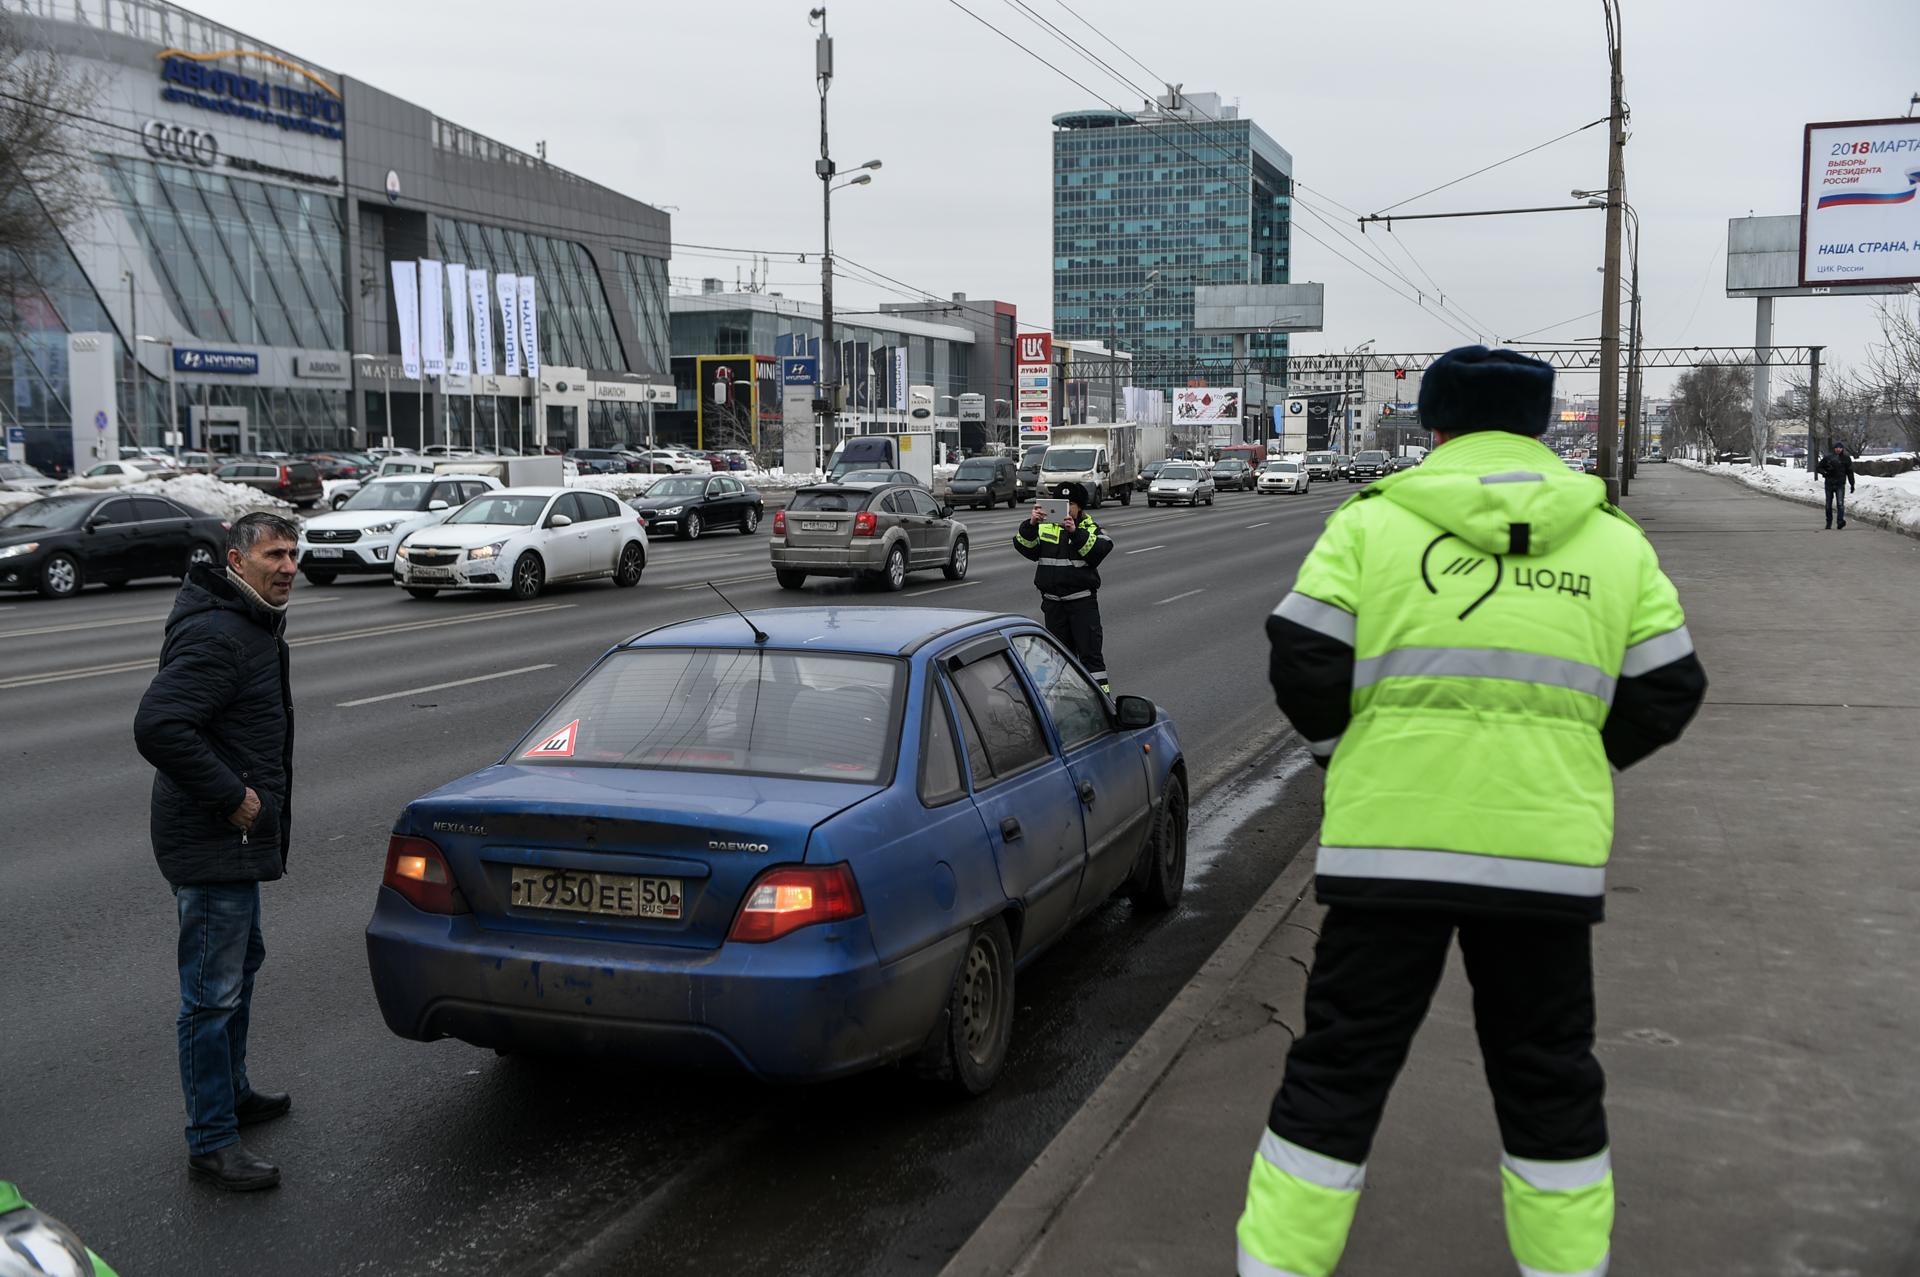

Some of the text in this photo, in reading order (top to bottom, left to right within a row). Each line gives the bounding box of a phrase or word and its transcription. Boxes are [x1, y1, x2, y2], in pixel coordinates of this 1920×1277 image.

[161, 58, 270, 107] АВИЛОН
[1828, 159, 1867, 168] ВЫБОРЫ
[1826, 167, 1882, 176] ПРЕЗИДЕНТА
[1823, 177, 1859, 185] РОССИИ
[1818, 244, 1854, 255] НАША
[1858, 240, 1909, 253] СТРАНА,
[1817, 265, 1835, 273] ЦИК
[204, 354, 256, 368] HYUNDAI
[308, 361, 341, 374] АВИЛОН
[756, 361, 776, 380] MINI
[597, 385, 626, 398] АВИЛОН
[962, 411, 981, 420] Jeep
[1515, 567, 1591, 600] ЦОДД
[543, 739, 567, 751] Ш
[433, 821, 467, 833] NEXIA
[708, 840, 769, 853] DAEWOO
[641, 880, 672, 905] 50
[641, 904, 664, 915] RUS
